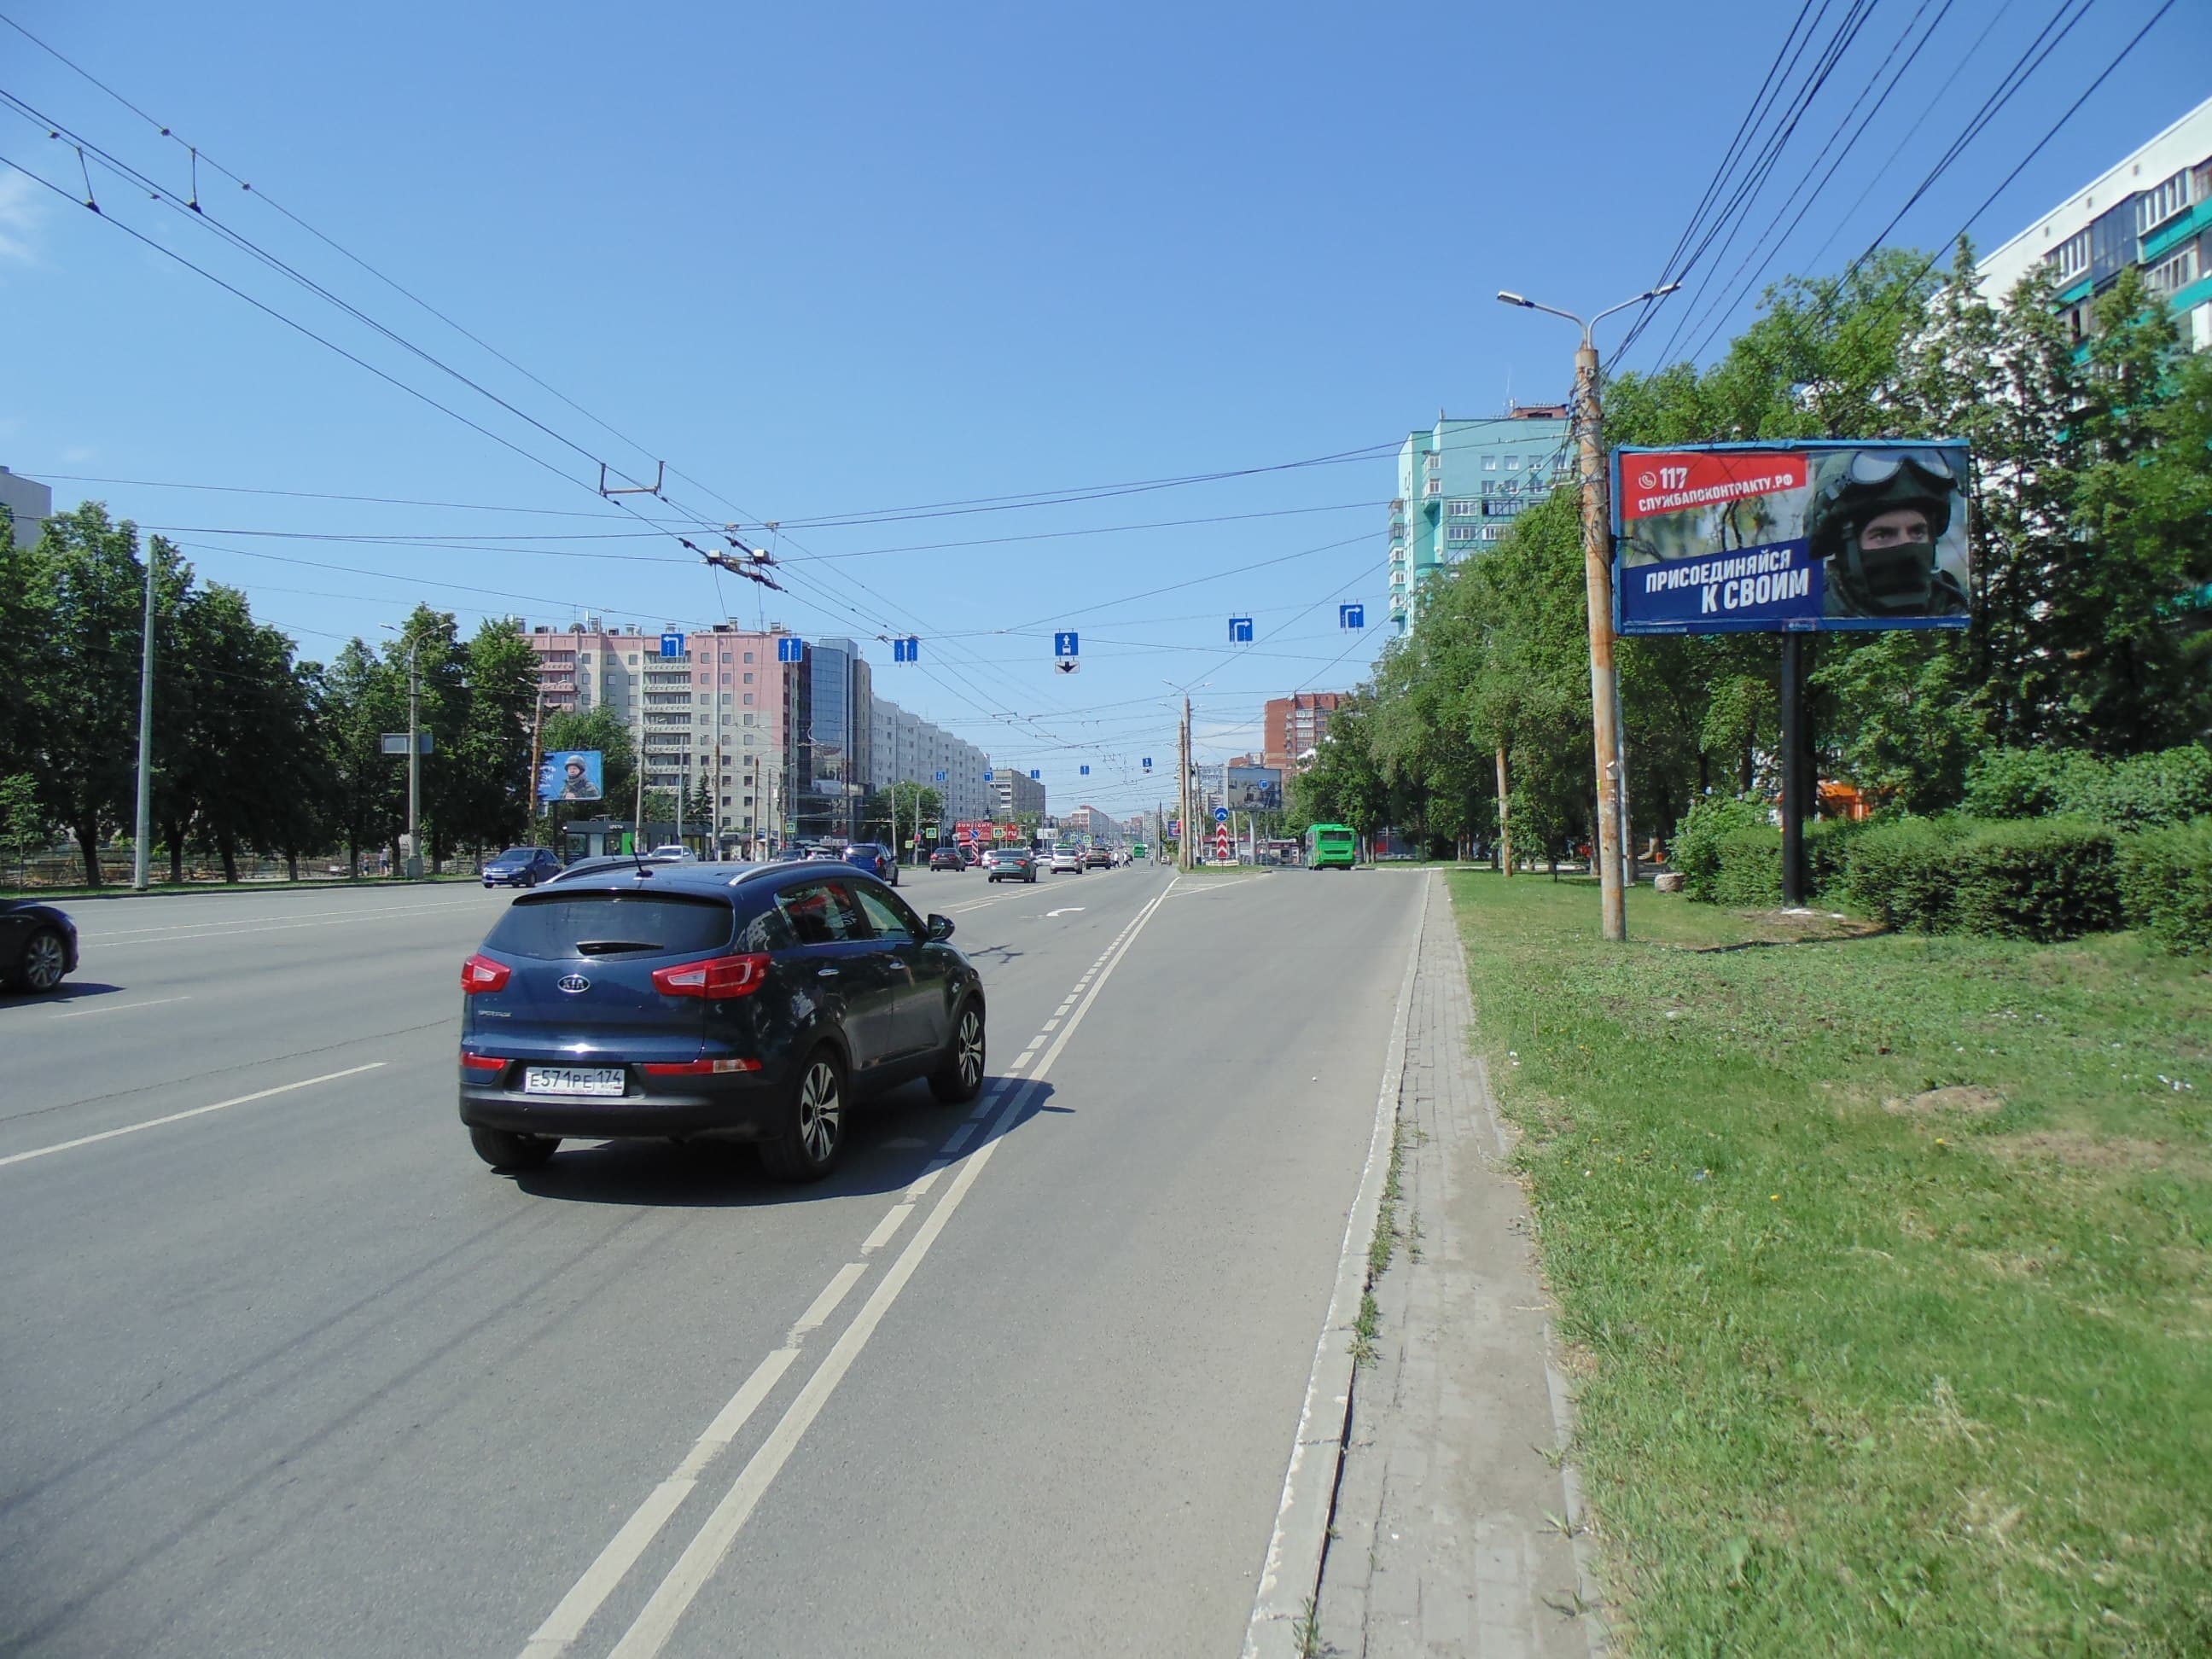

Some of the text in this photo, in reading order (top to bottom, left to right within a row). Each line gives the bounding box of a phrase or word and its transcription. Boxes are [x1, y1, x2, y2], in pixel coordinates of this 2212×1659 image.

[1660, 467, 1688, 490] 117
[1645, 549, 1791, 593] ПРИСОЕДИНЯЙСЯ
[1701, 568, 1809, 614] К СВОИМ
[564, 979, 585, 988] KIA
